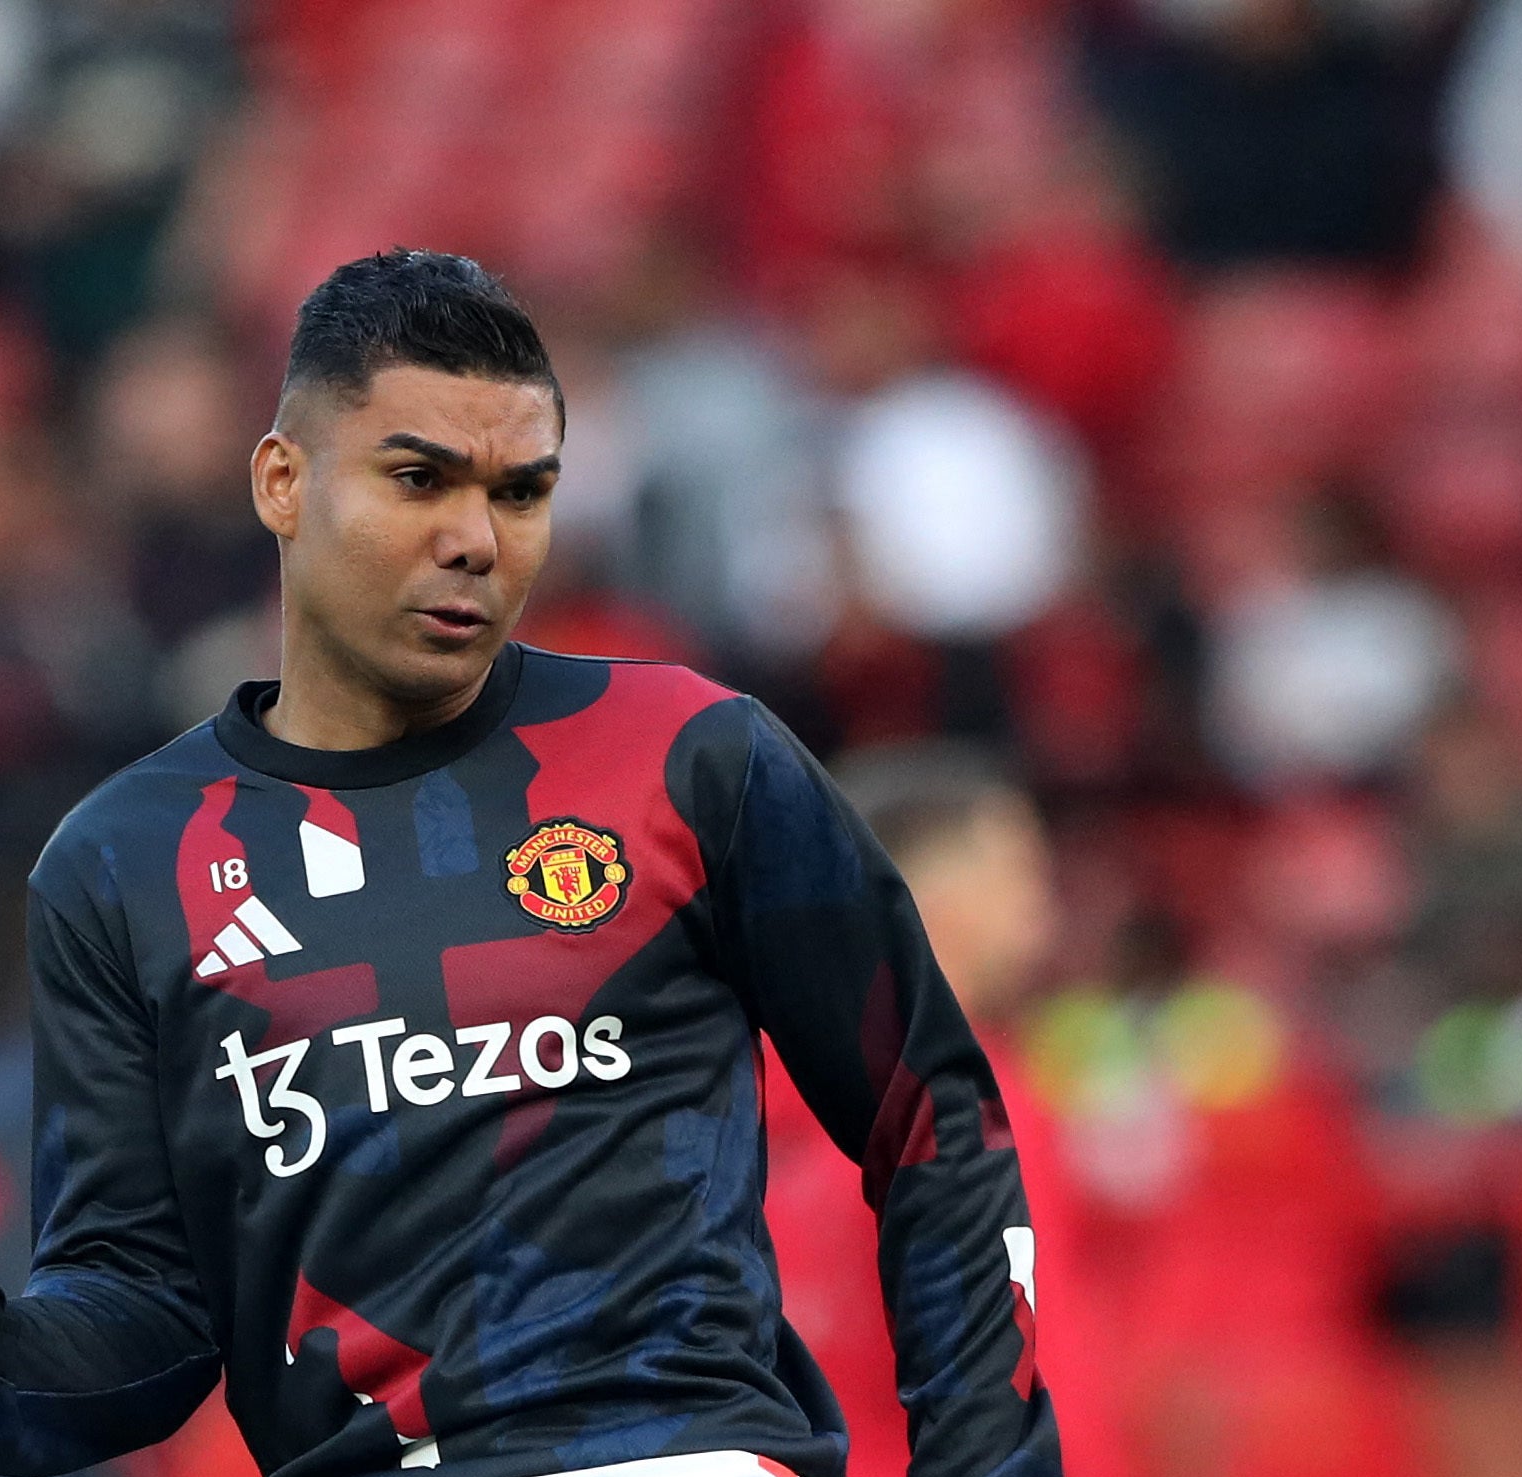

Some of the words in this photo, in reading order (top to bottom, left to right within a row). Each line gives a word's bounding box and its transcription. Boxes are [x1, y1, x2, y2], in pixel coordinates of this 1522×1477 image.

[518, 830, 608, 869] MANCHESTER
[210, 858, 249, 893] 18
[540, 899, 607, 920] UNITED
[331, 1014, 632, 1114] Tezos
